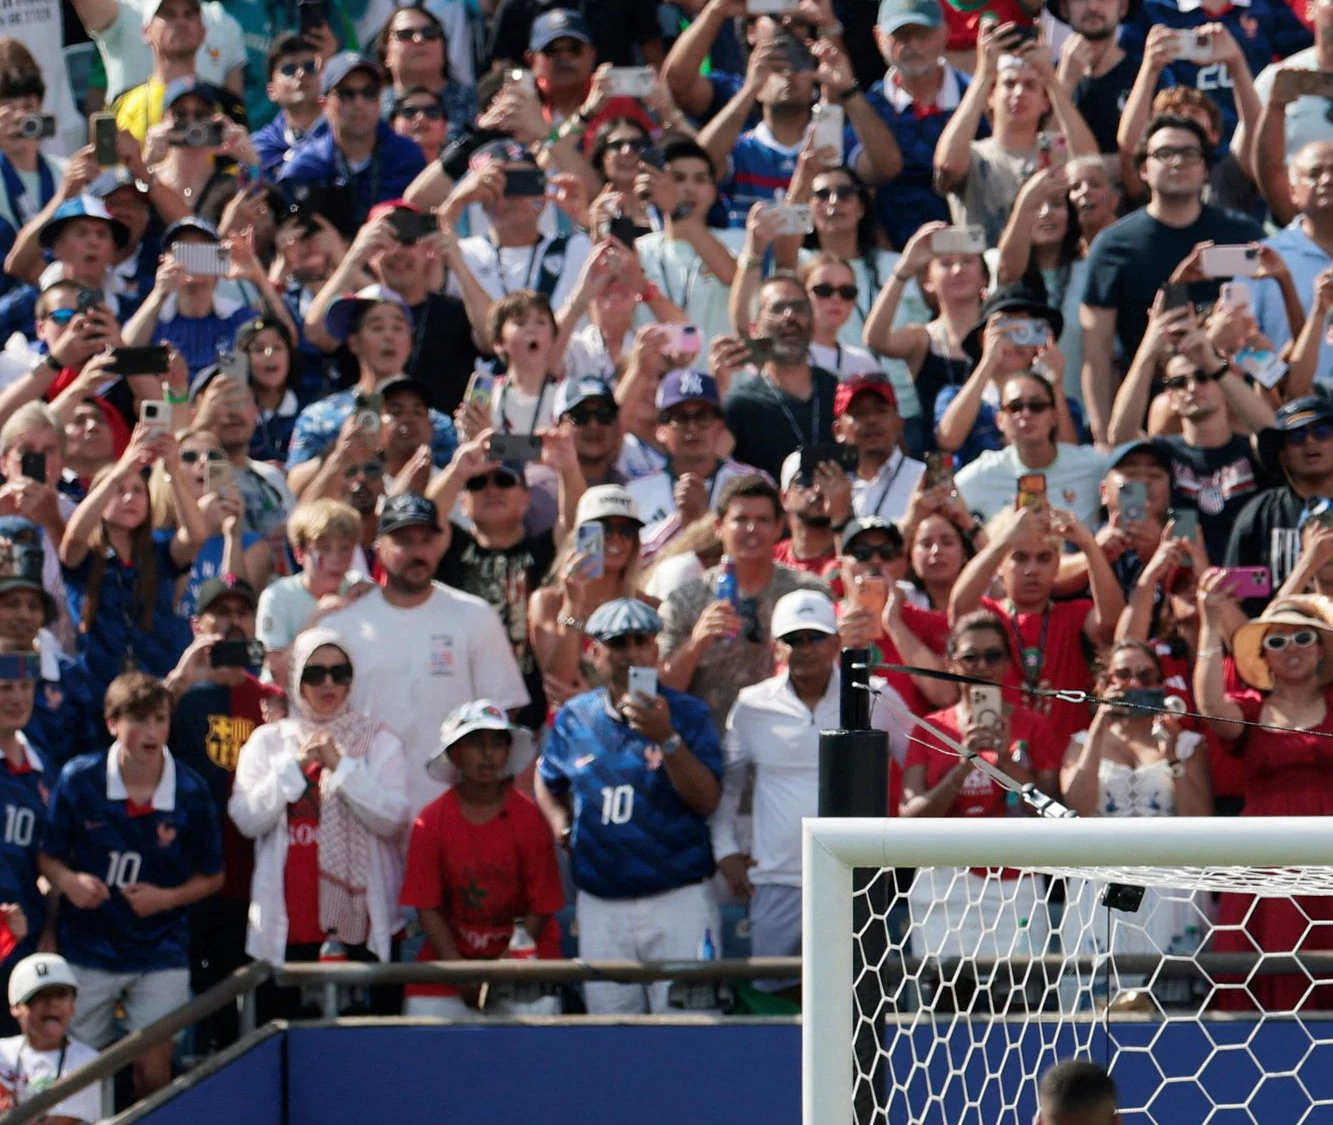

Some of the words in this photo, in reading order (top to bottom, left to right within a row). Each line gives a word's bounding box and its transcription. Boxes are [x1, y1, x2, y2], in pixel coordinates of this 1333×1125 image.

[4, 804, 36, 847] 10
[601, 784, 635, 826] 10
[106, 851, 143, 888] 10
